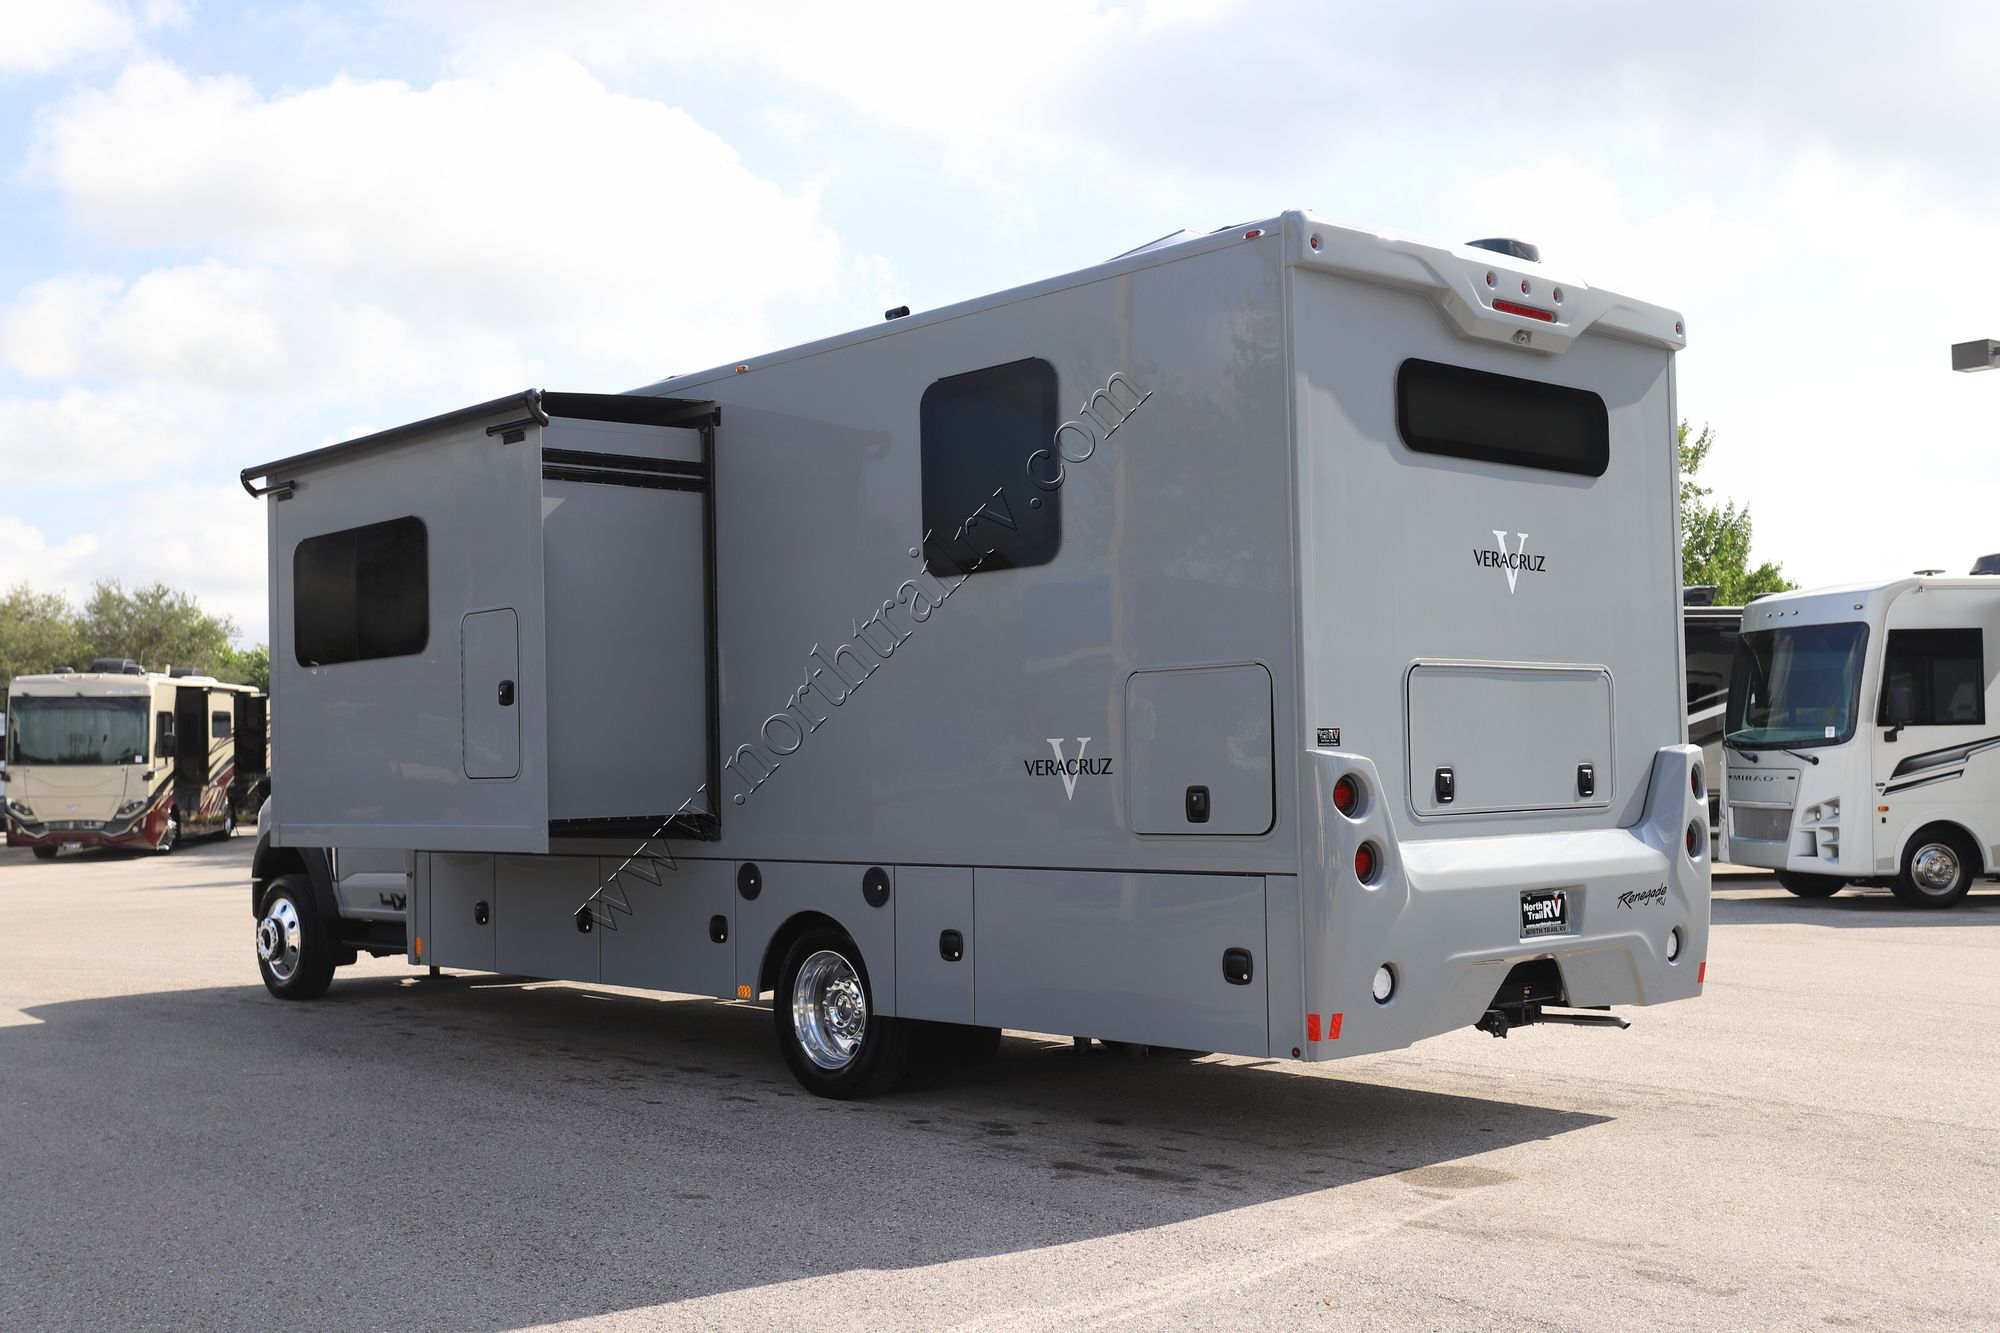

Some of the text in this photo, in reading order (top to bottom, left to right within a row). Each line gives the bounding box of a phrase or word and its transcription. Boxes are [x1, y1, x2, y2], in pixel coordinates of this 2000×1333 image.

[1473, 549, 1546, 572] VERACRUZ
[1023, 758, 1114, 776] VERACRUZ
[1617, 882, 1667, 910] Renegade
[1655, 896, 1667, 906] RV
[1523, 902, 1543, 912] North
[1543, 899, 1562, 918] RV
[1527, 910, 1543, 920] Trail
[1525, 927, 1543, 935] NORTH
